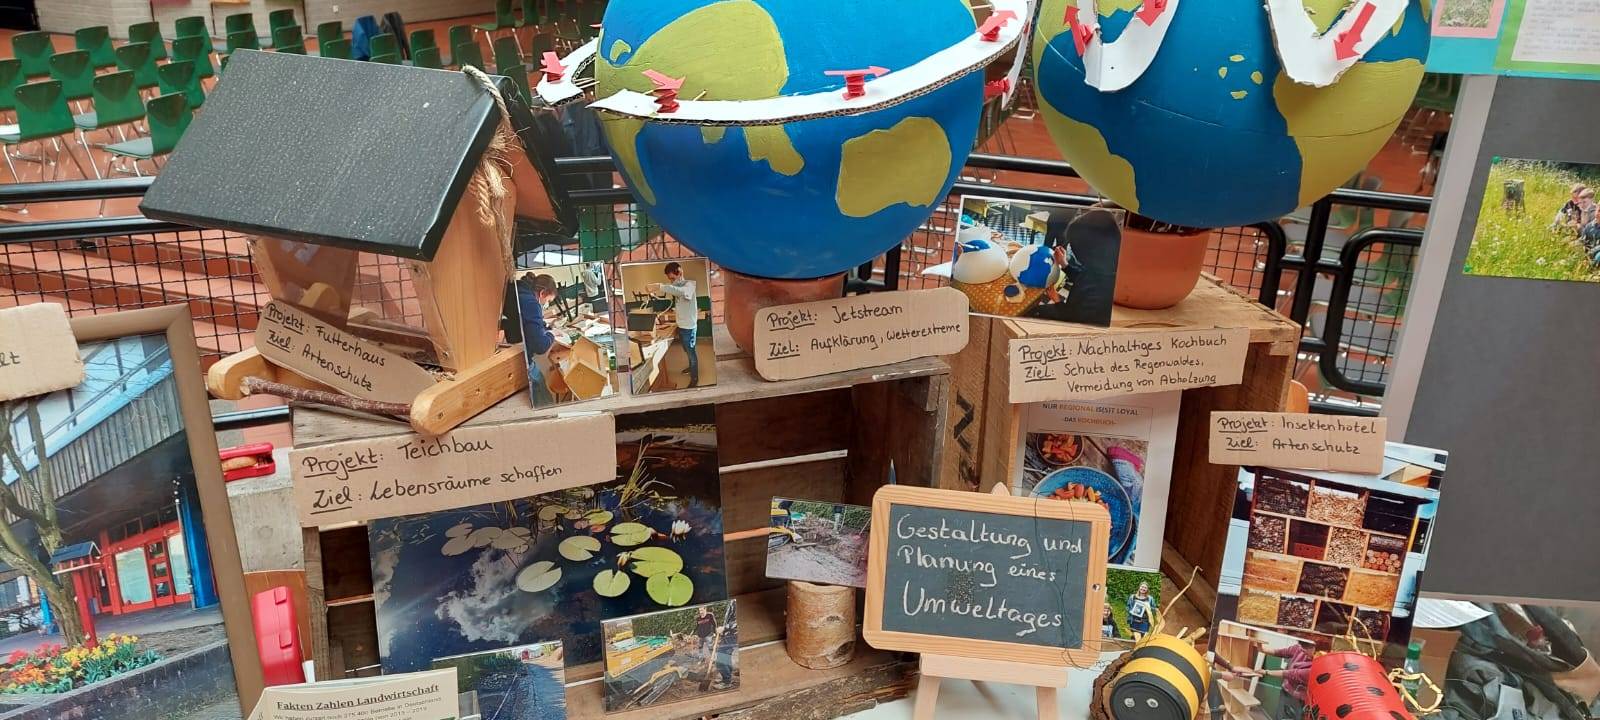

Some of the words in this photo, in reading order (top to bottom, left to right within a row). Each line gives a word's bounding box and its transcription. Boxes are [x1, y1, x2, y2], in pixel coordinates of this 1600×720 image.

[767, 310, 818, 330] Projekt:
[832, 305, 903, 324] Jetstream
[266, 303, 310, 334] Projekt:
[315, 324, 386, 366] Futterhaus
[769, 340, 800, 358] Ziel:
[887, 322, 961, 341] Wetterextreme
[1018, 342, 1073, 365] Projekt:
[1077, 339, 1162, 357] Nachhaltiges
[1171, 334, 1227, 349] Kochbuch
[268, 329, 296, 351] Ziel:
[302, 343, 373, 391] Artenschutz
[1024, 365, 1055, 380] Ziel:
[1064, 362, 1105, 376] Schutz
[1110, 361, 1130, 372] des
[1067, 379, 1134, 393] Vermeidung
[1136, 378, 1154, 386] von
[1160, 372, 1216, 386] Abholzung
[1059, 404, 1094, 413] REGIONAL
[1117, 408, 1139, 416] LOYAL
[1217, 416, 1274, 433] Projekt:
[1282, 416, 1377, 434] Insektenhotel
[302, 450, 384, 481] Projekt:
[398, 434, 493, 461] Teichbau
[1226, 436, 1259, 450] Ziel:
[1272, 438, 1361, 455] Artenschutz
[312, 486, 362, 510] Ziel:
[370, 474, 491, 502] Lebensräume
[500, 464, 562, 484] schaffen
[896, 513, 1032, 560] Gestaltung
[1043, 536, 1082, 554] und
[896, 544, 998, 588] Planung
[1007, 562, 1056, 582] eines
[903, 579, 1063, 637] Umweltages
[277, 701, 314, 711] Fakten
[316, 700, 354, 711] Zahlen
[357, 684, 440, 705] Landwirtschaft
